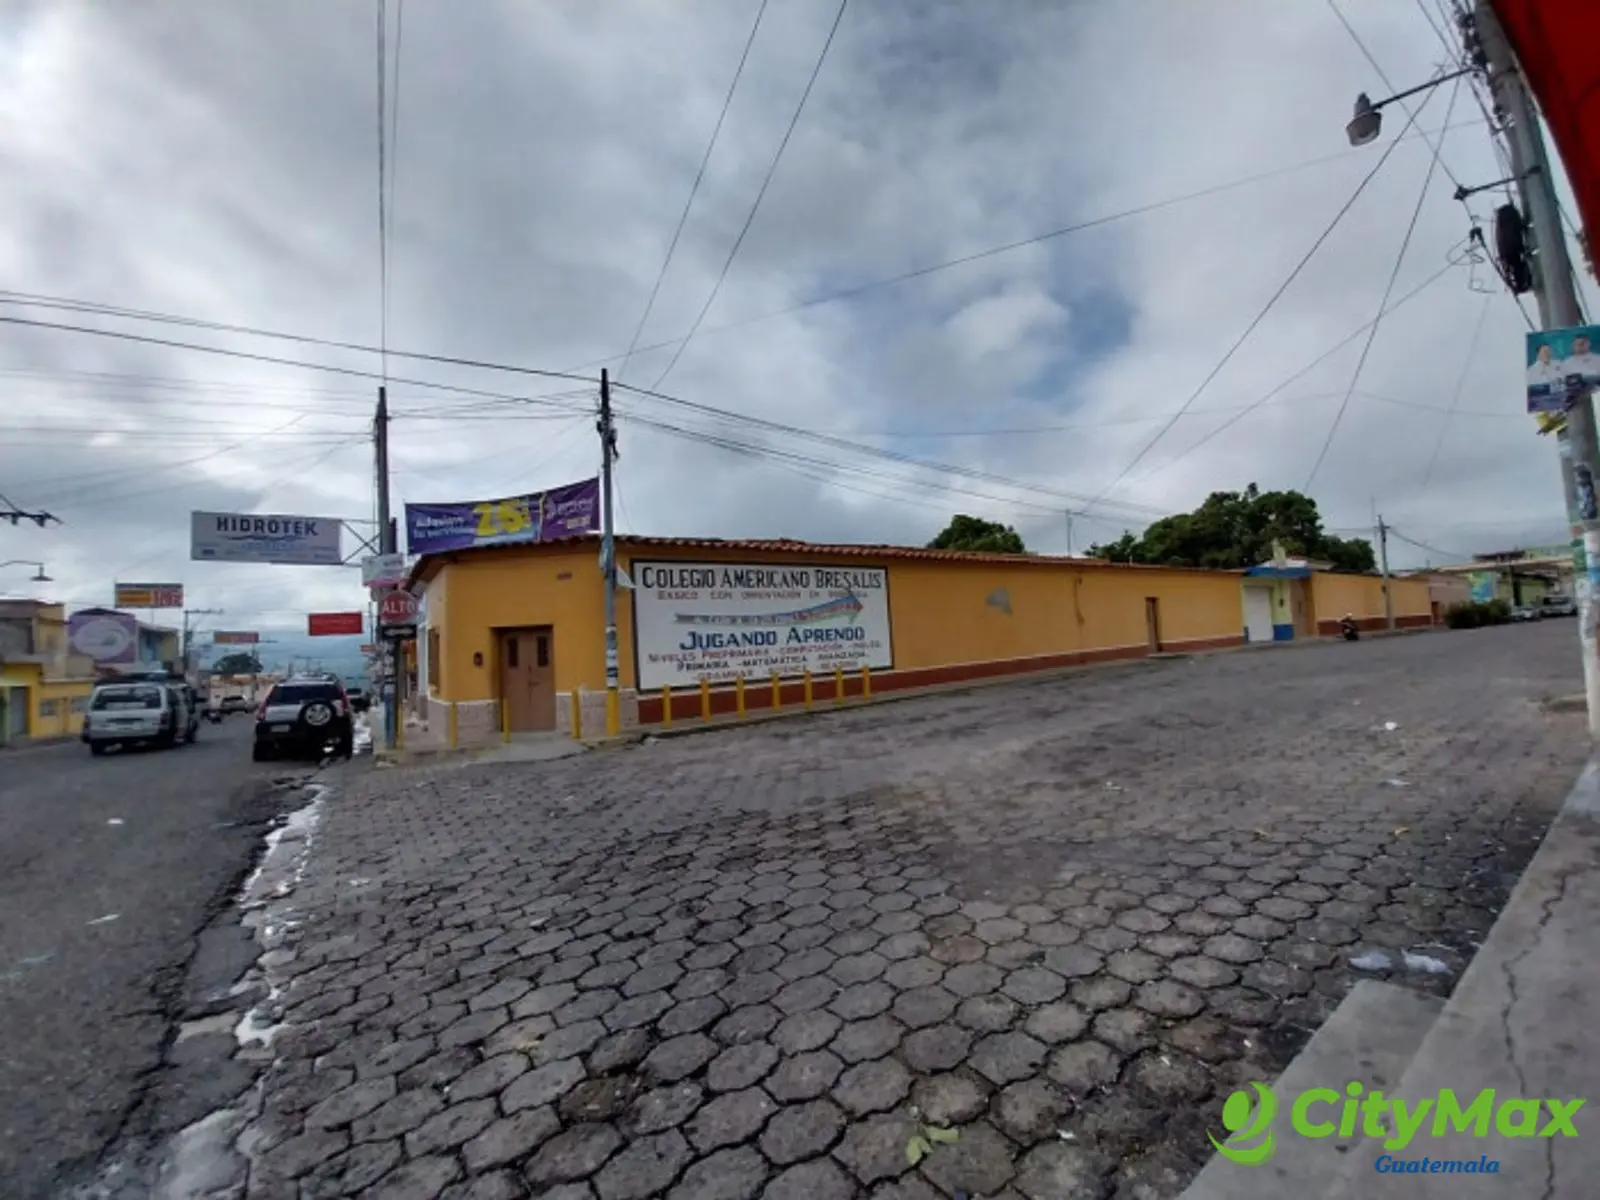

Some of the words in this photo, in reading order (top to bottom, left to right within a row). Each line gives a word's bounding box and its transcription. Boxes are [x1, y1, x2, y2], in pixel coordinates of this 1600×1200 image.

[216, 516, 319, 537] HIDROTEK
[642, 566, 716, 589] COLEGIO
[720, 568, 811, 589] AMERICANO
[383, 600, 417, 614] ALTO
[679, 631, 778, 650] JUGANDO
[786, 626, 866, 645] APRENDO
[676, 660, 730, 673] PRIMARIA
